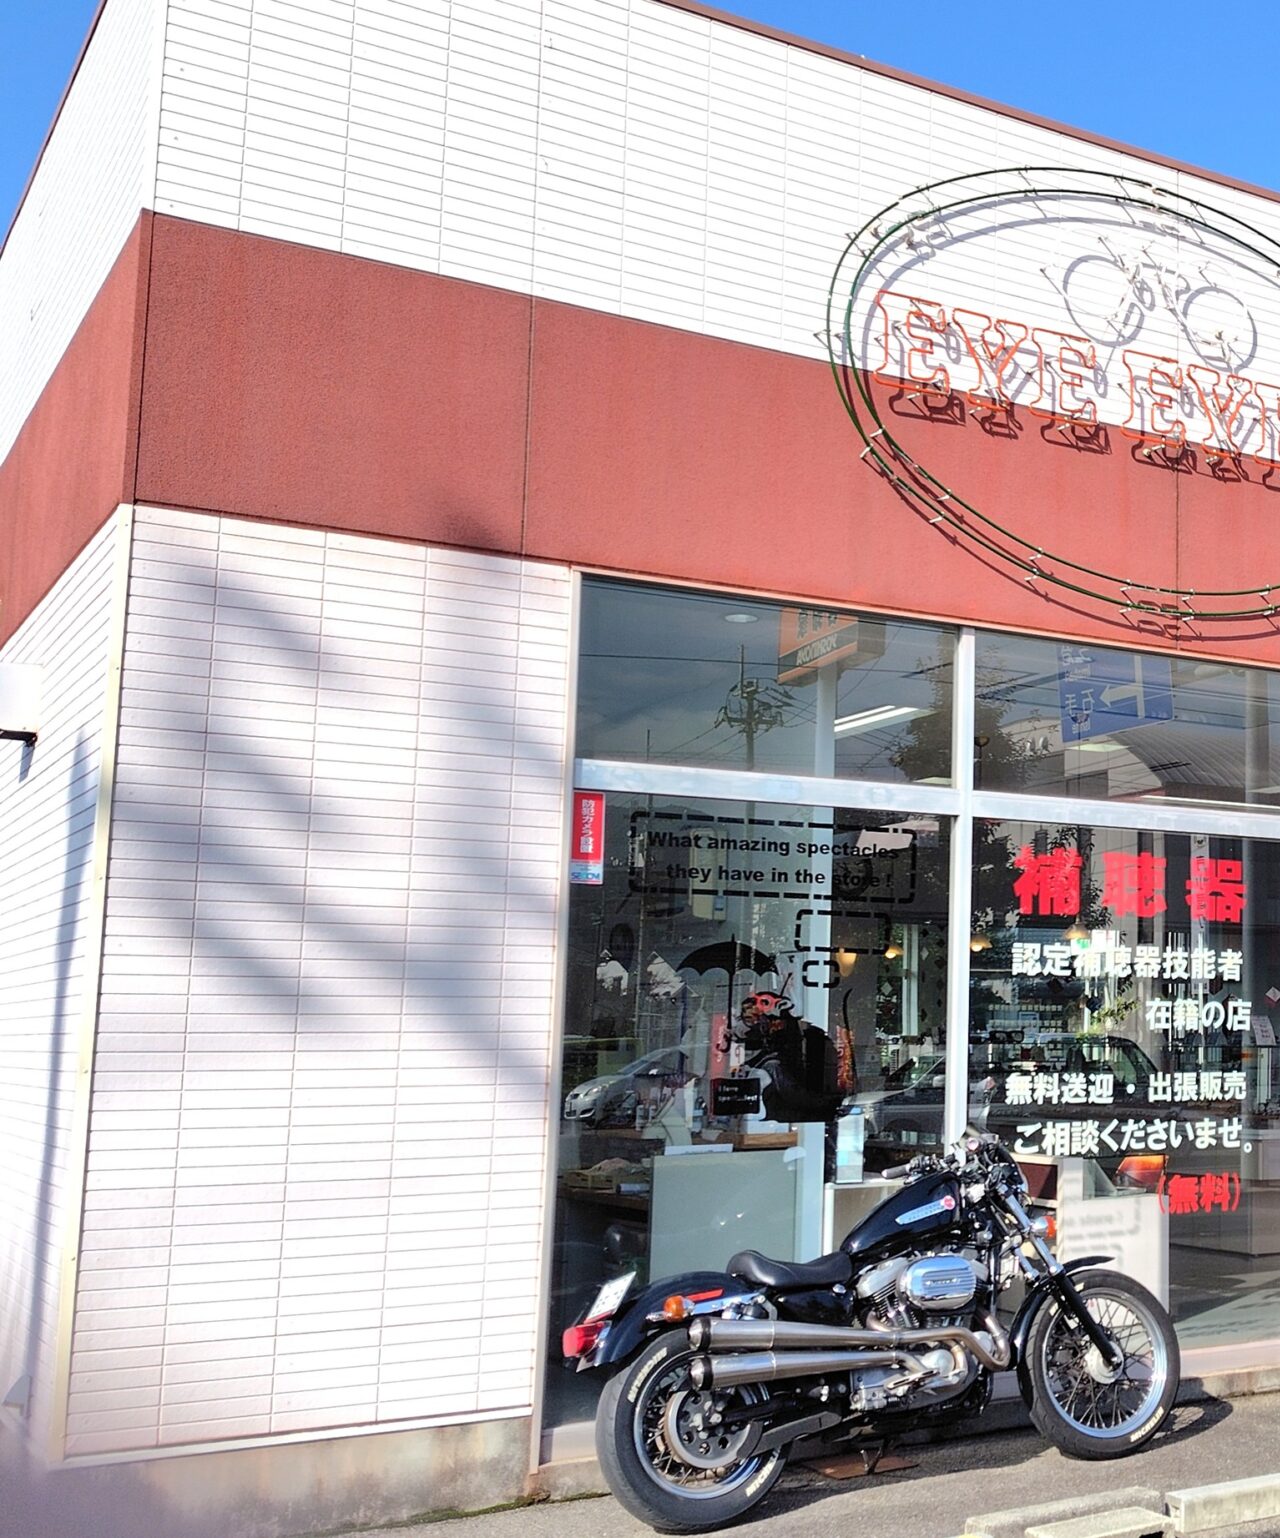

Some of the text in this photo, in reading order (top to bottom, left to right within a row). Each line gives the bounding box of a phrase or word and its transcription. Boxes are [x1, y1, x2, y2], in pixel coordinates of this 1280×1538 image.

[874, 290, 1097, 425] EYE
[648, 831, 899, 860] What amazing spectacles
[666, 864, 712, 883] they
[718, 865, 764, 882] have
[771, 867, 789, 883] in
[795, 869, 826, 884] the
[832, 871, 881, 888] store
[1013, 845, 1248, 924] 補聴器
[1011, 941, 1243, 982] 認定補聴器技能者
[1145, 998, 1252, 1031] 在籍の店
[1005, 1071, 1247, 1105] 無料送迎・出張販売
[1014, 1117, 1252, 1156] ご相談くださいませ。
